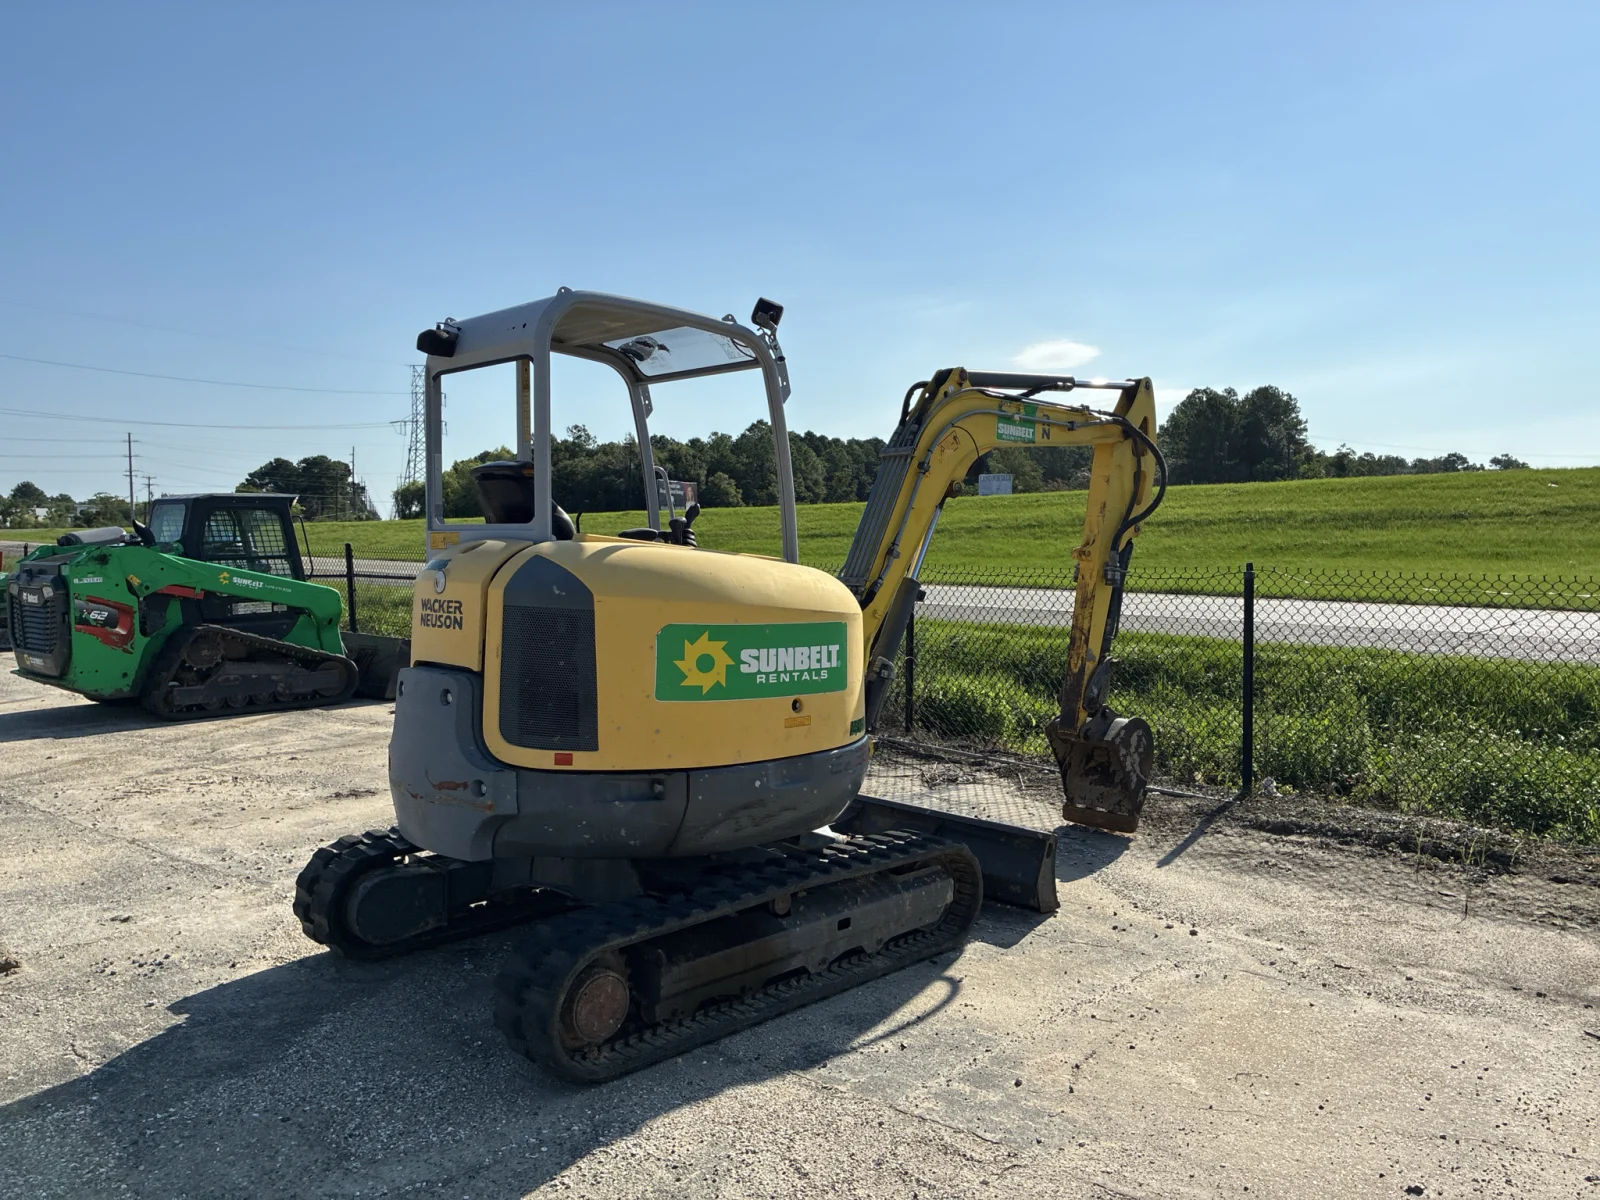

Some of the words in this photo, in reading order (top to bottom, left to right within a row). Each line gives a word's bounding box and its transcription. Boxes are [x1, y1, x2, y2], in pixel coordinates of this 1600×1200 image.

[998, 423, 1034, 438] SUNBELT
[1041, 427, 1051, 440] N
[421, 598, 463, 615] WACKER
[420, 613, 463, 630] NEUSON
[740, 644, 840, 673] SUNBELT
[756, 670, 828, 684] RENTALS
